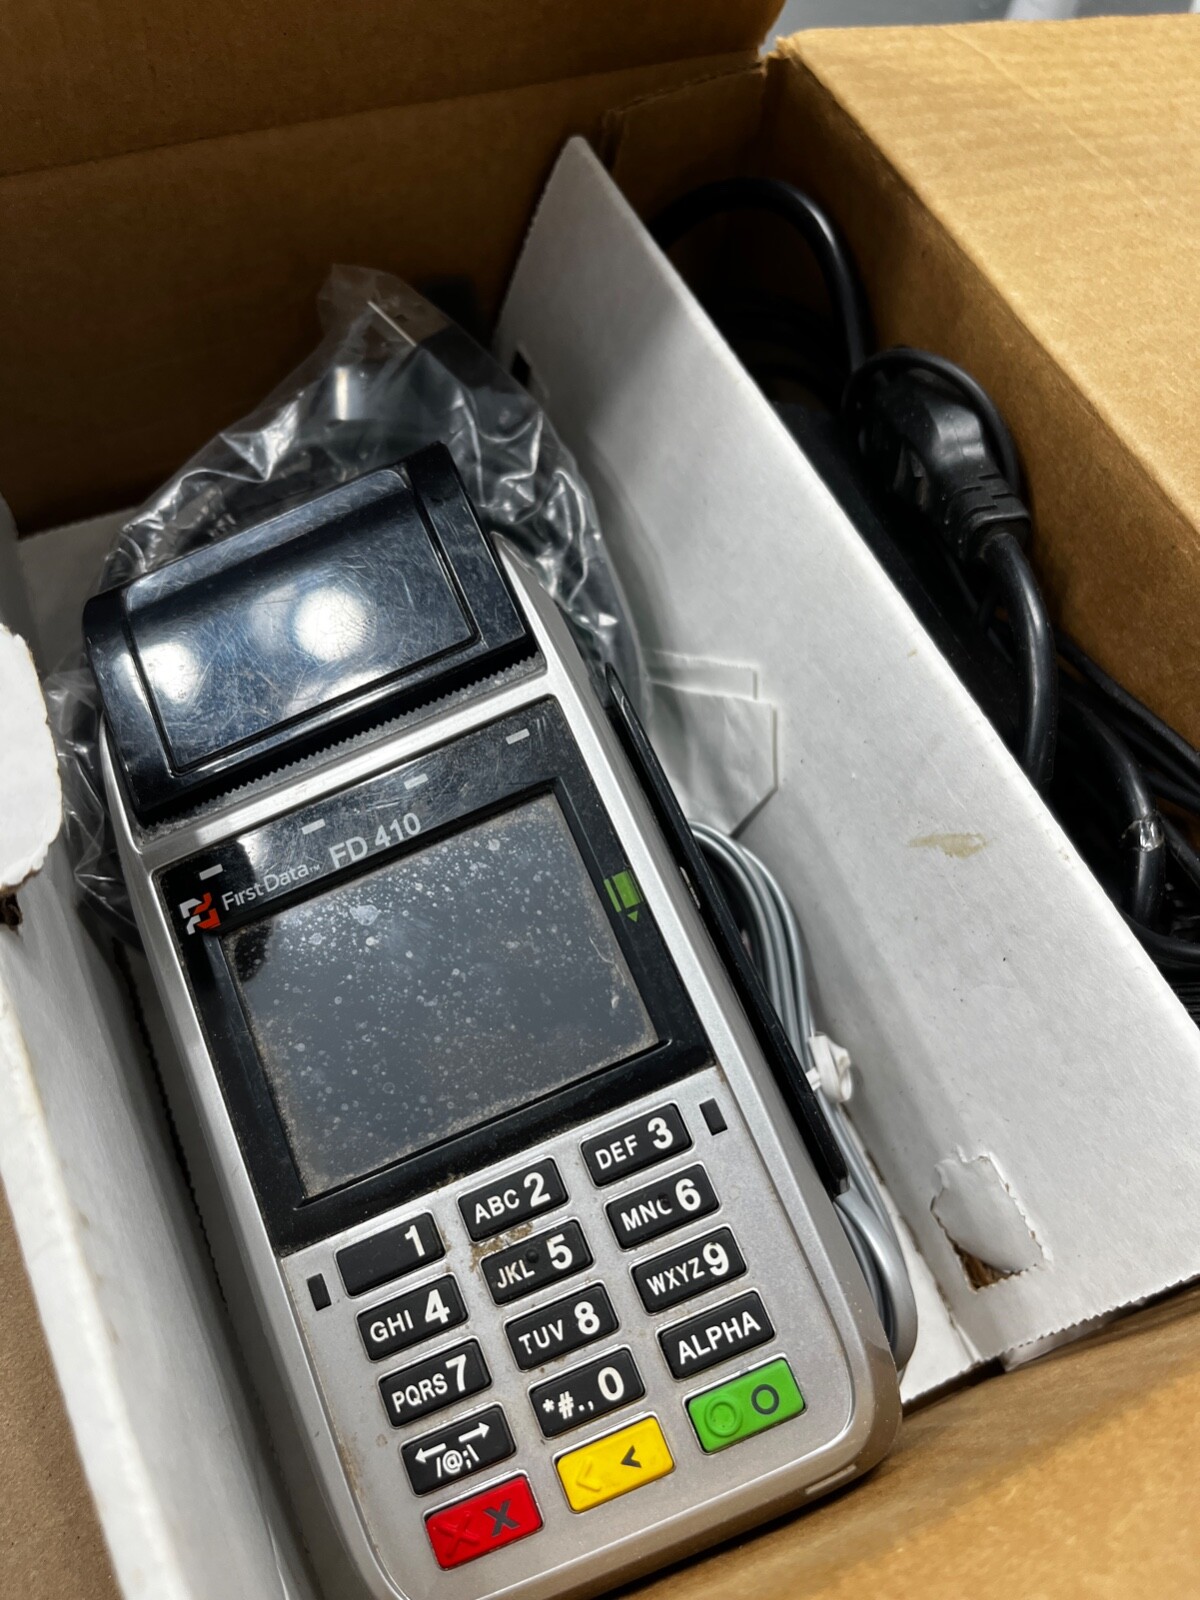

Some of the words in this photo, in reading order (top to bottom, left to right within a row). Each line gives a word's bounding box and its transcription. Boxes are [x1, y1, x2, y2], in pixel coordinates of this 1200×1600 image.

[329, 836, 368, 870] FD
[374, 812, 422, 847] 410
[595, 1134, 638, 1170] DEF
[647, 1117, 673, 1149] 3
[474, 1189, 520, 1224] ABC
[523, 1172, 551, 1207] 2
[675, 1178, 701, 1211] 6
[404, 1224, 426, 1257] 1
[497, 1259, 535, 1289] JKL
[546, 1234, 573, 1269] 5
[646, 1257, 705, 1296] WXYZ
[702, 1241, 729, 1276] 9
[369, 1309, 414, 1343] GHI
[424, 1289, 450, 1324] 4
[518, 1319, 564, 1355] TUV
[574, 1301, 600, 1335] 8
[677, 1311, 762, 1365] ALPHA
[391, 1372, 448, 1413] PQRS
[445, 1353, 468, 1392] 7
[597, 1366, 625, 1401] 0
